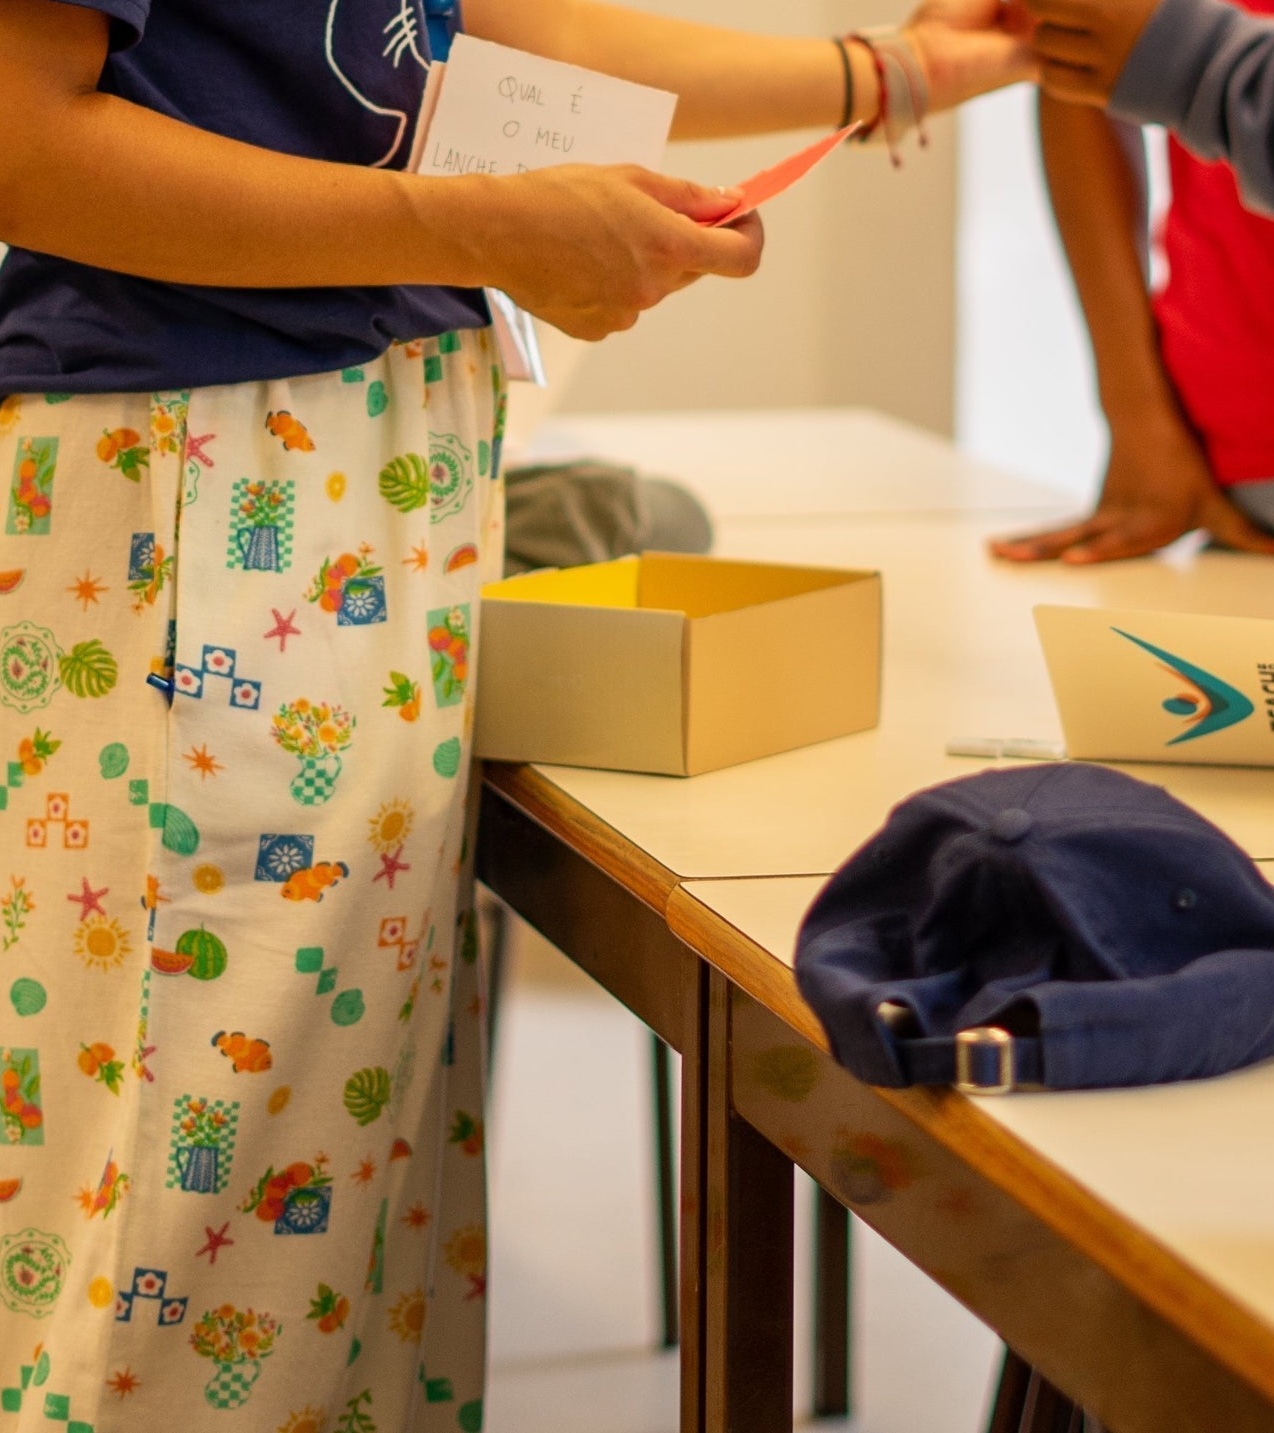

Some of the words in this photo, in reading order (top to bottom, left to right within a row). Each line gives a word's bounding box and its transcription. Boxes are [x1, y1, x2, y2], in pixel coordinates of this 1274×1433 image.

[498, 76, 545, 106] QUAL
[570, 86, 583, 115] É
[502, 120, 521, 138] O
[535, 129, 575, 153] MEU
